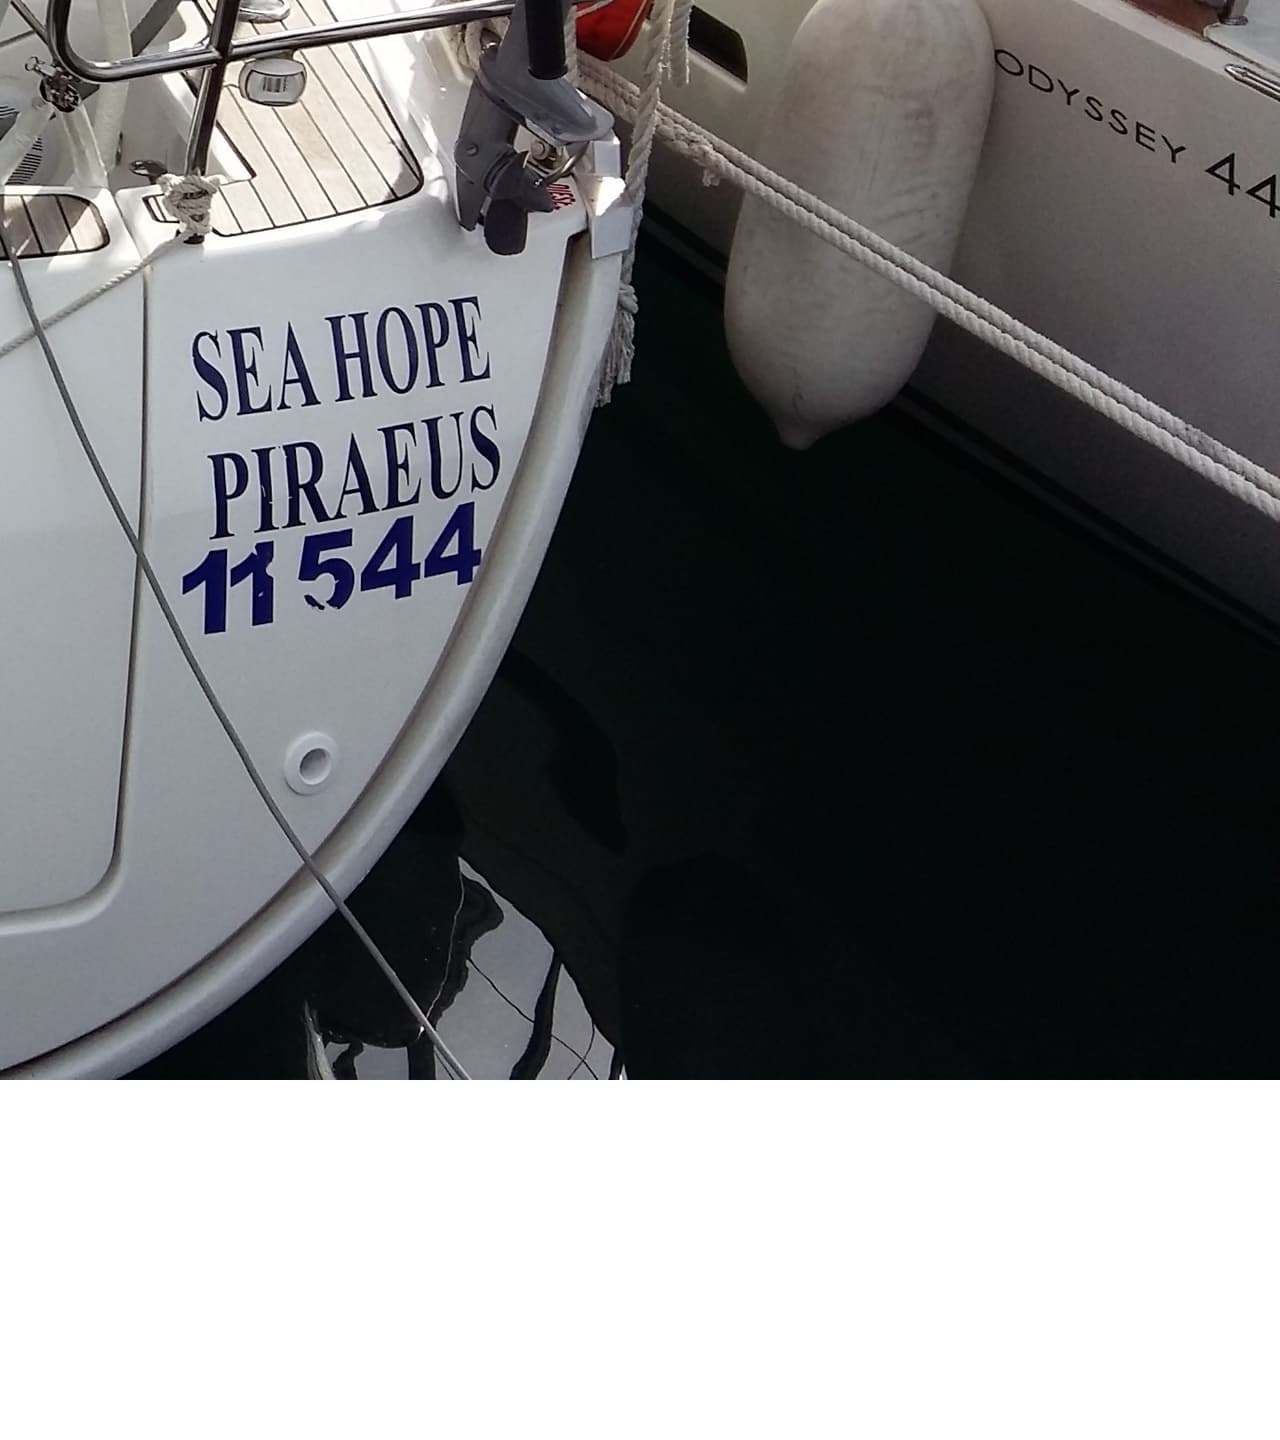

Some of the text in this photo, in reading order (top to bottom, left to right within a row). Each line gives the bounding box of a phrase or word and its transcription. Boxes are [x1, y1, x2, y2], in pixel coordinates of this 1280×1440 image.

[994, 49, 1186, 163] ODYSSEY
[192, 296, 490, 422] SEA HOPE
[207, 404, 500, 540] PIRAEUS
